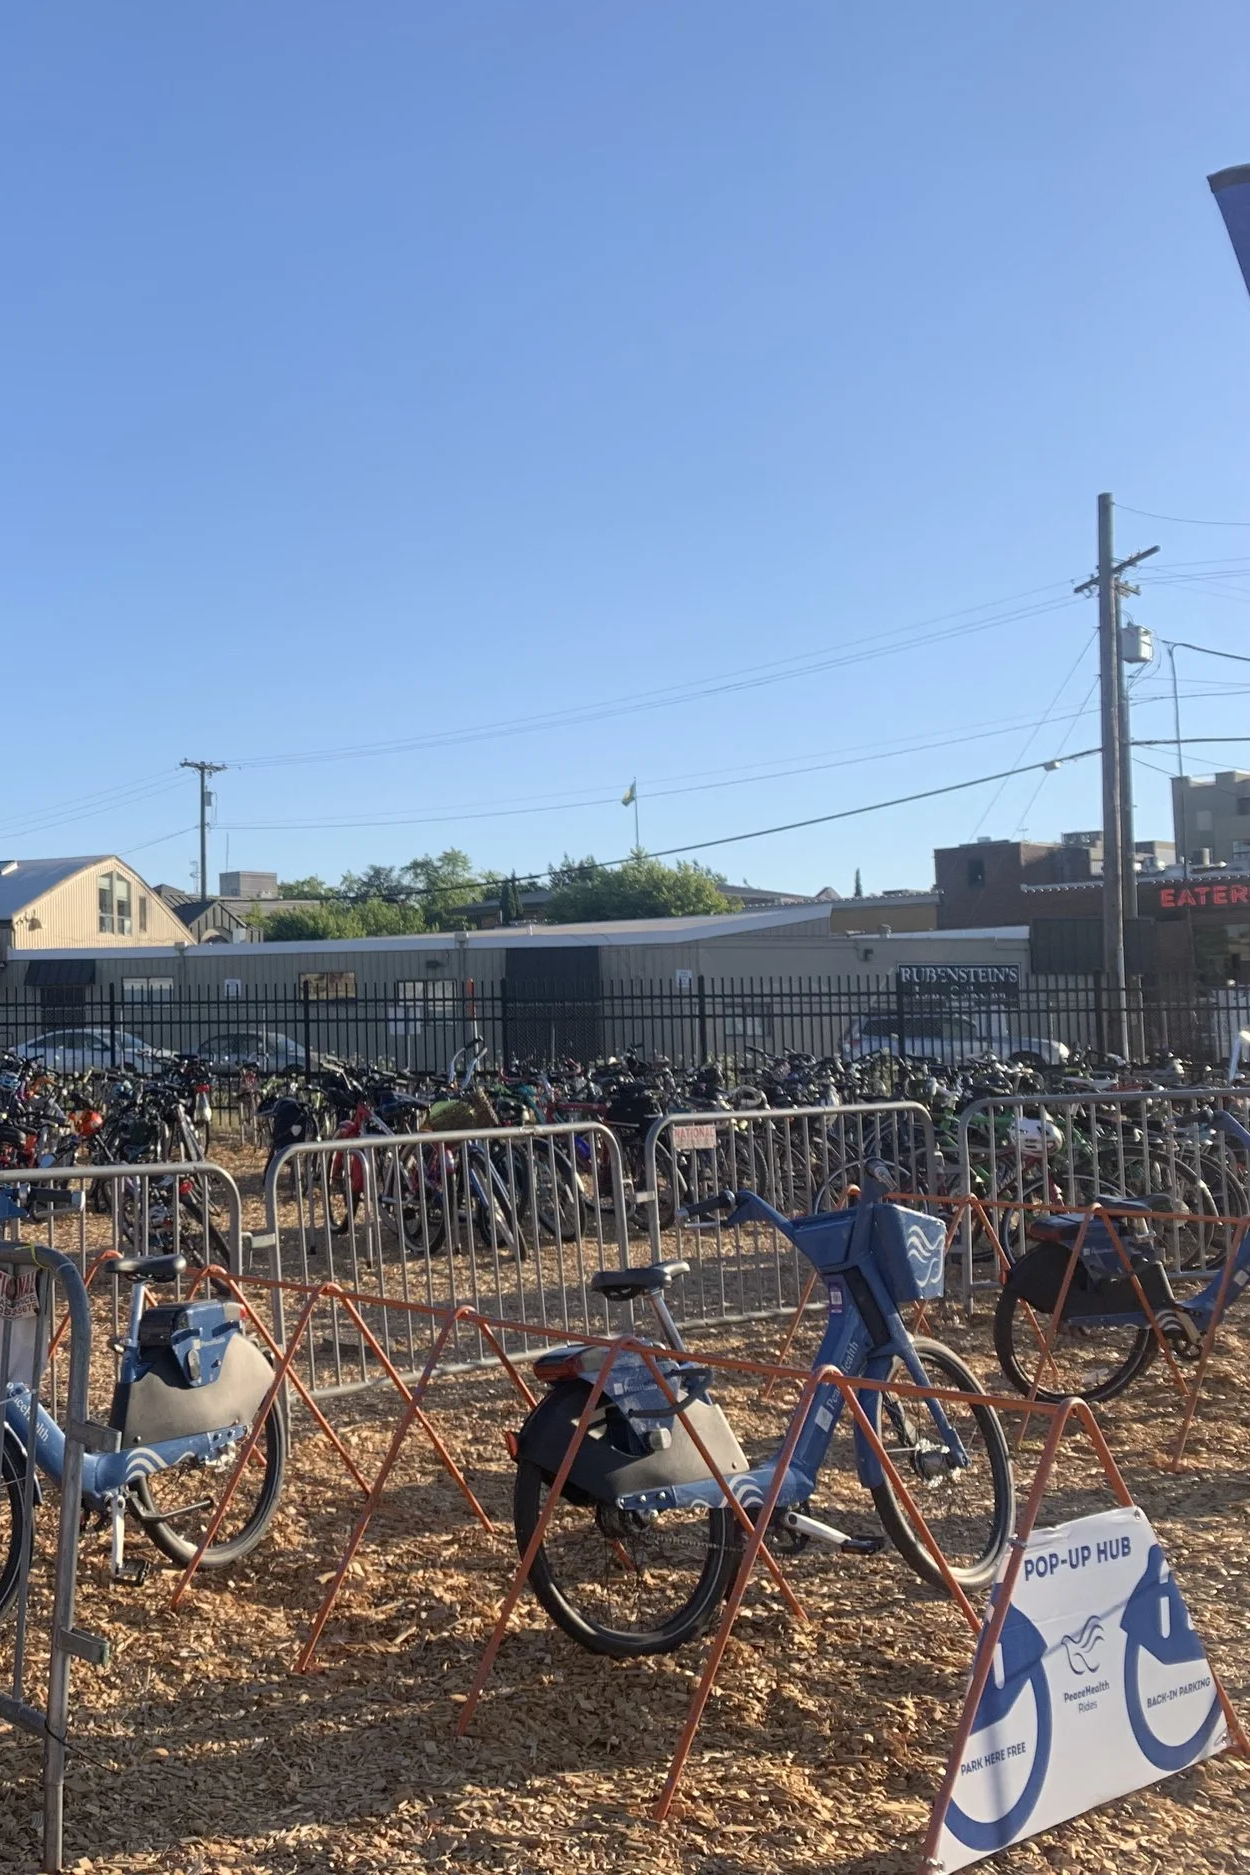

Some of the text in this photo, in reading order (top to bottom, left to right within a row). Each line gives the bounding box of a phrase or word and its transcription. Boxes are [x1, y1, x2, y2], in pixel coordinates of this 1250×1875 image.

[1161, 885, 1250, 907] EATER
[900, 967, 1018, 983] RUBENSTEIN'S
[674, 1127, 715, 1138] NATIONAL
[1024, 1536, 1132, 1581] POP-UP HUB
[1063, 1680, 1110, 1703] PeaceHealth
[1147, 1677, 1211, 1708] BACK-IN PARKING
[1078, 1701, 1098, 1714] Rides
[961, 1742, 1027, 1776] PARK HERE FREE
